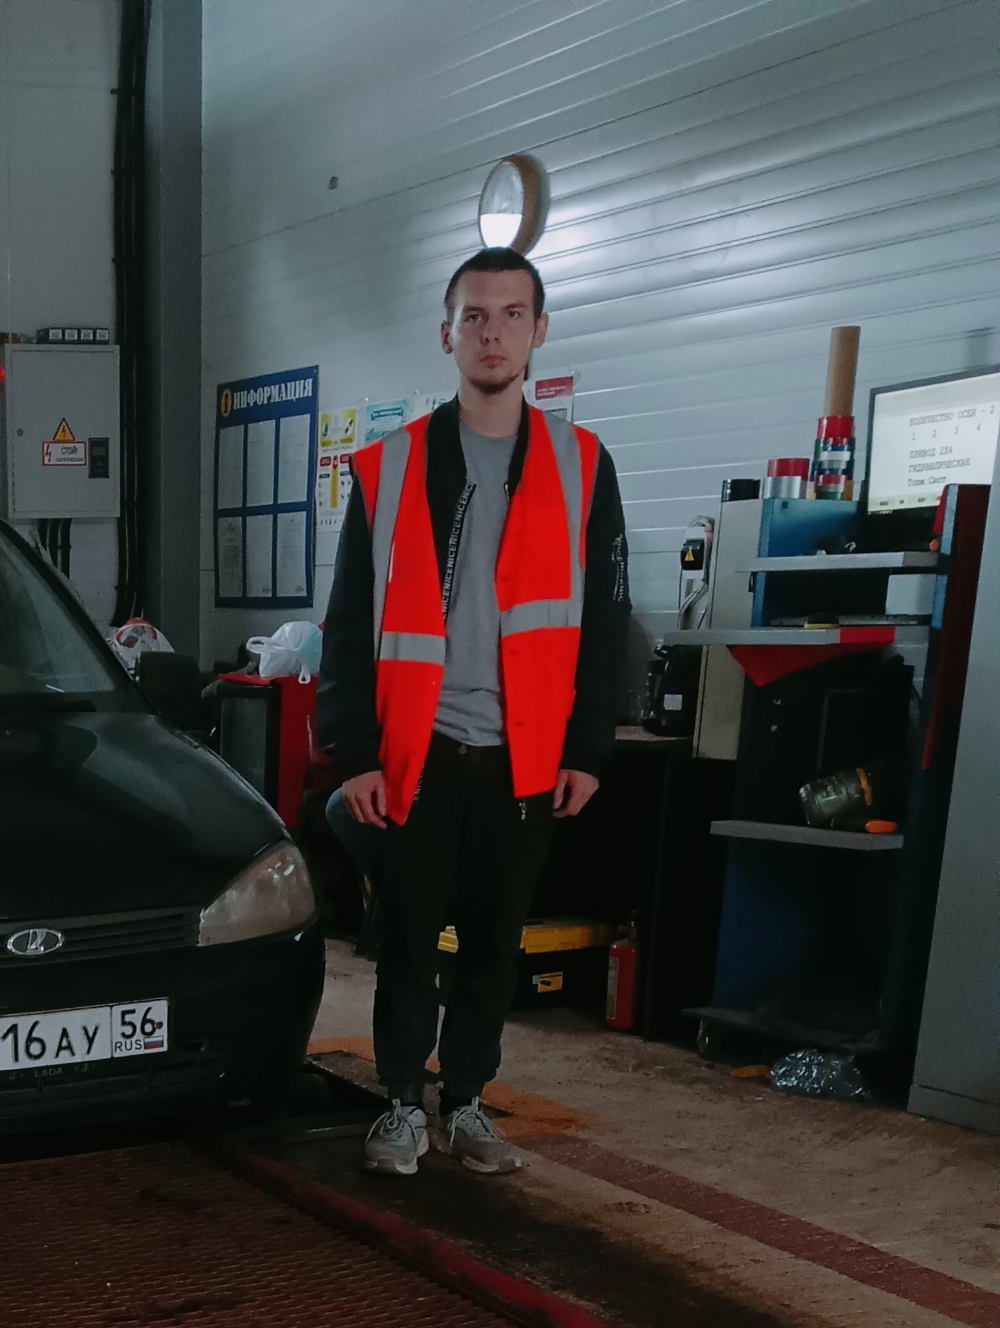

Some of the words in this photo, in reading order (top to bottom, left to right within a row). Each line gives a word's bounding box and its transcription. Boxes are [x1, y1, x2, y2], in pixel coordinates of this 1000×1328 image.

[233, 378, 313, 410] ИНФОРМАЦИЯ
[61, 445, 78, 455] СТОЙ
[120, 1006, 157, 1040] 56
[114, 1037, 143, 1053] RUS
[34, 1067, 63, 1079] LADA
